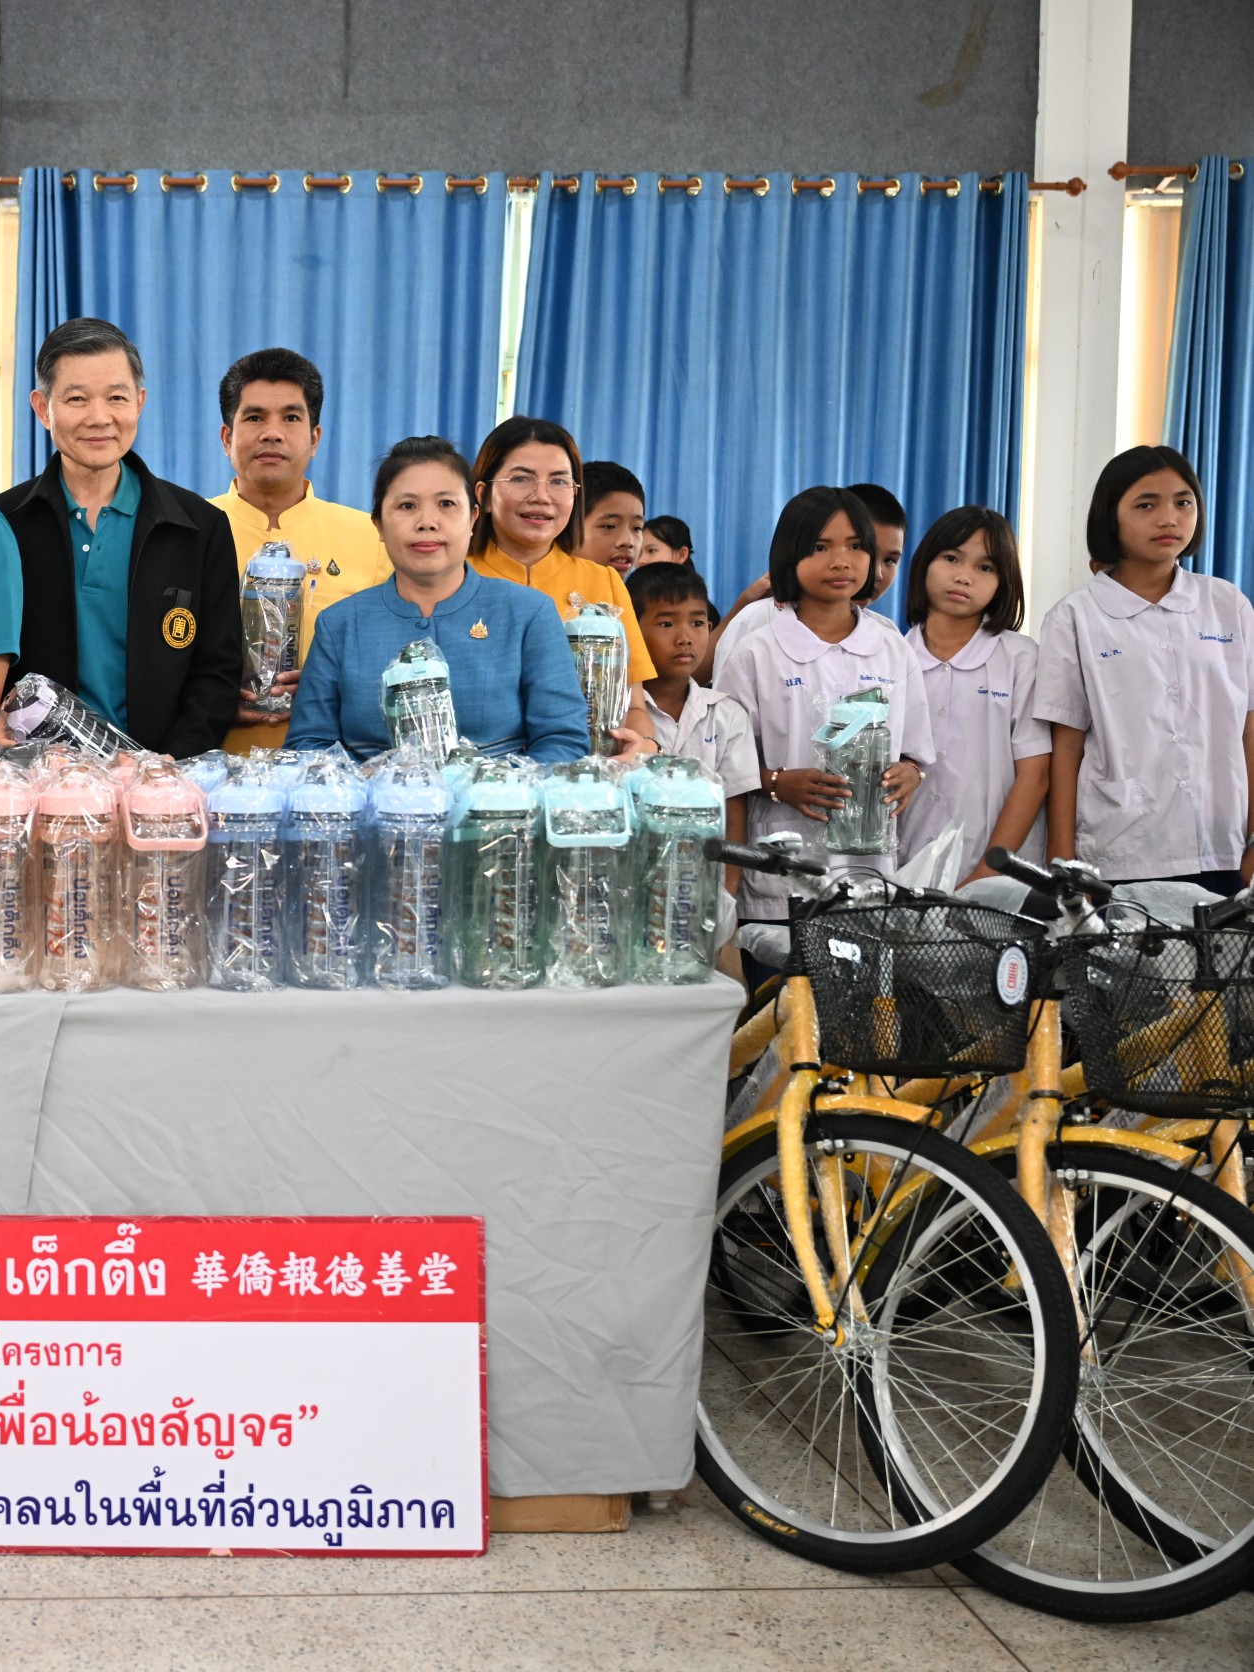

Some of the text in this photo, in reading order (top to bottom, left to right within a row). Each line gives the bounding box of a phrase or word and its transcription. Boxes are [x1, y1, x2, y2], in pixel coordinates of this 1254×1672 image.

[190, 1249, 458, 1298] 華僑報德善堂
